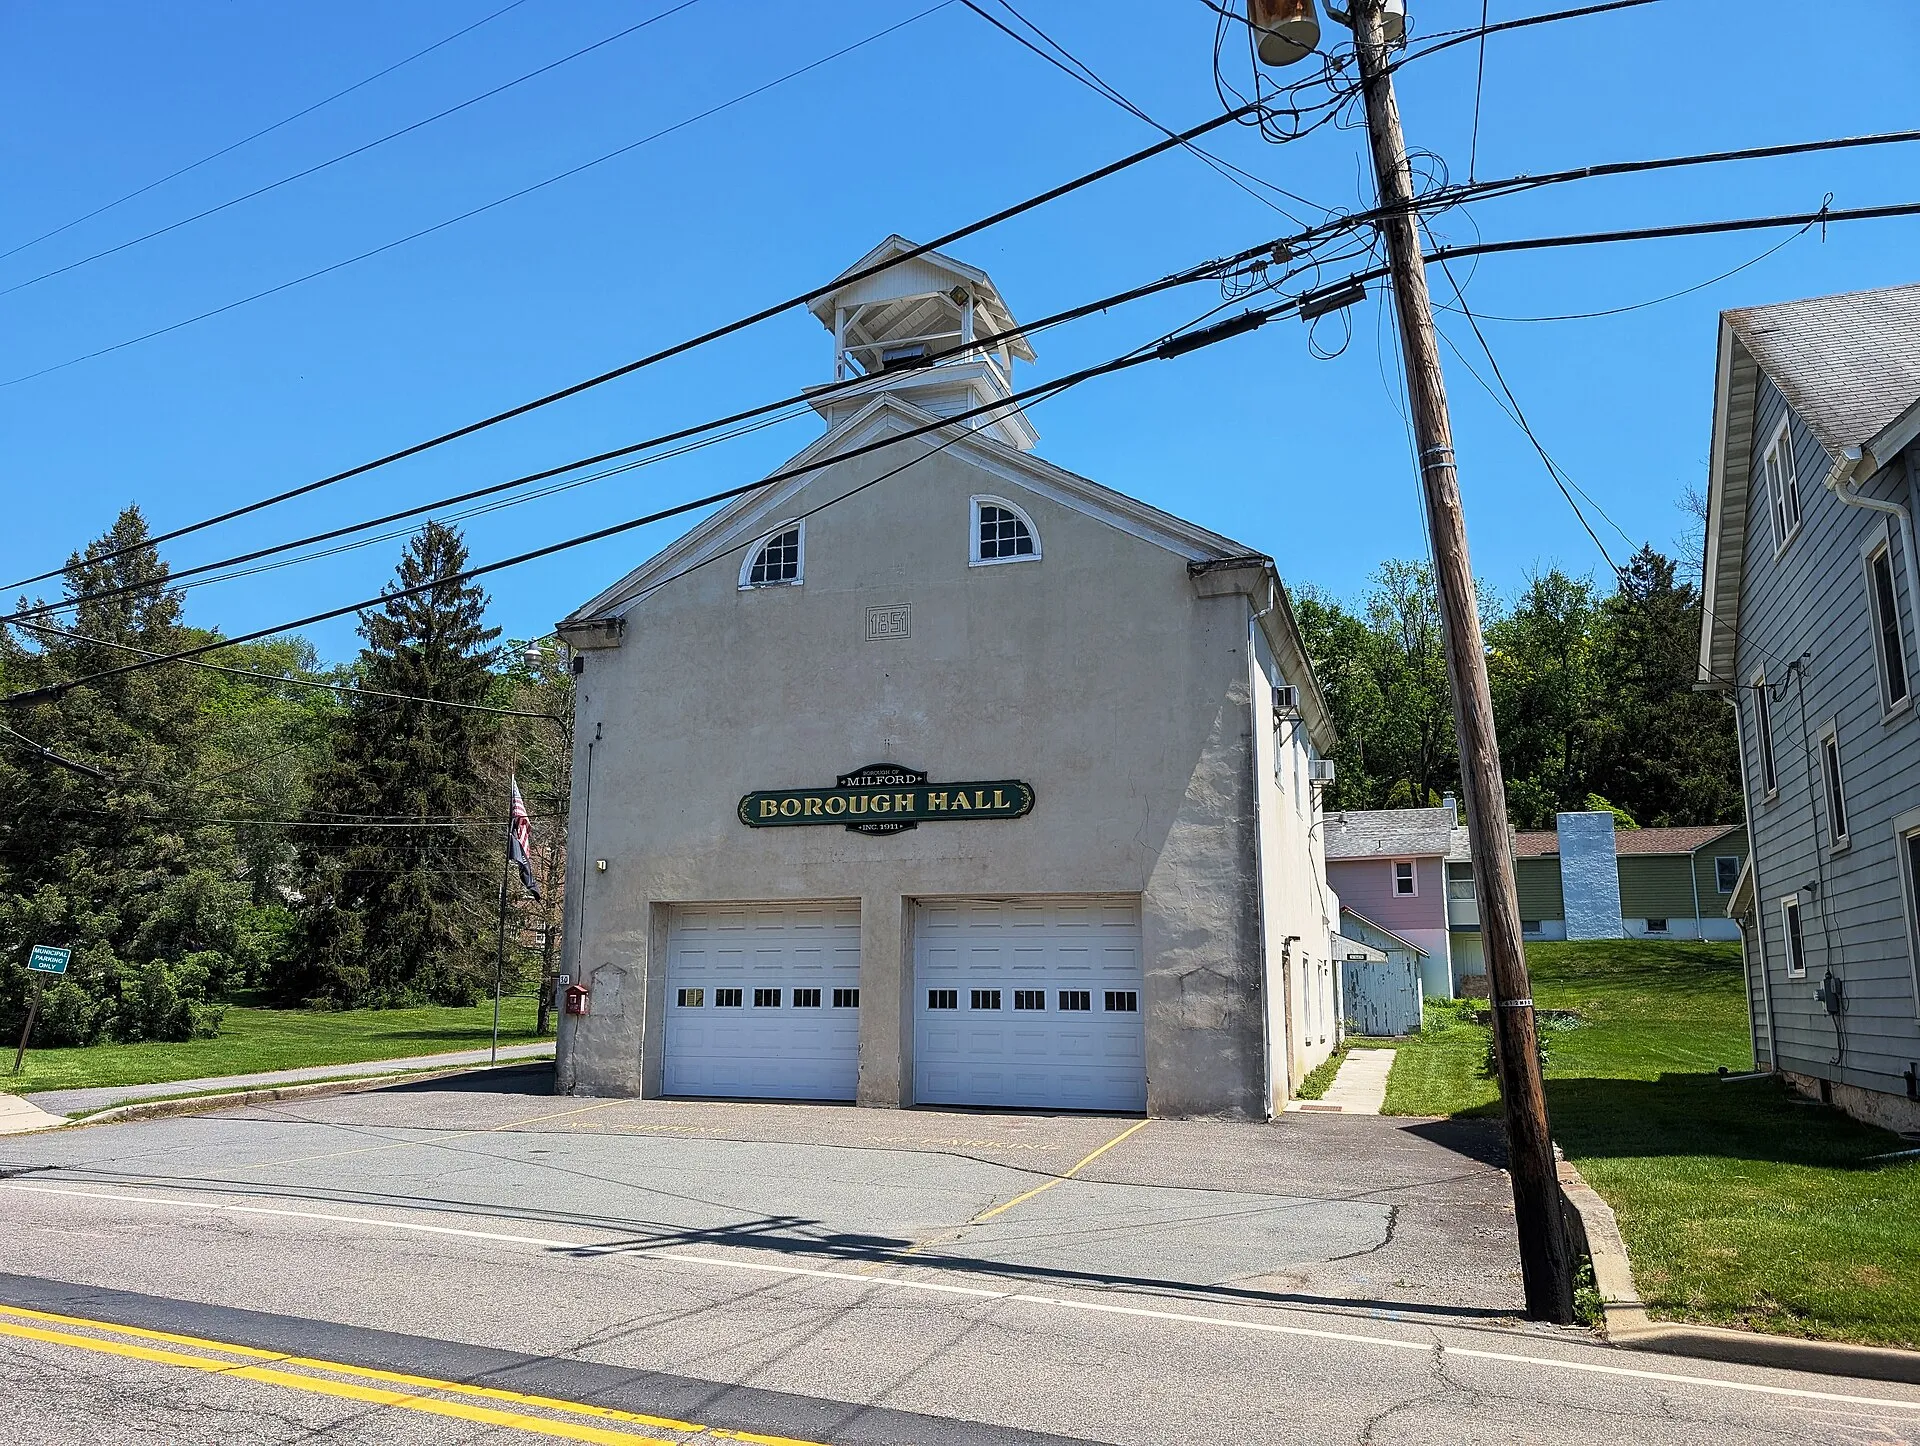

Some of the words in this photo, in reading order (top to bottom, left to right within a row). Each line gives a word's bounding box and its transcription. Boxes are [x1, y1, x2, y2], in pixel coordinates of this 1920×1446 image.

[871, 611, 906, 634] 1851
[847, 775, 916, 787] MILFORD
[759, 793, 915, 818] BOROUGH
[927, 790, 1011, 811] HALL
[34, 947, 67, 958] MUNICIPAL
[35, 954, 63, 964] PARKING
[39, 962, 56, 970] ONLY
